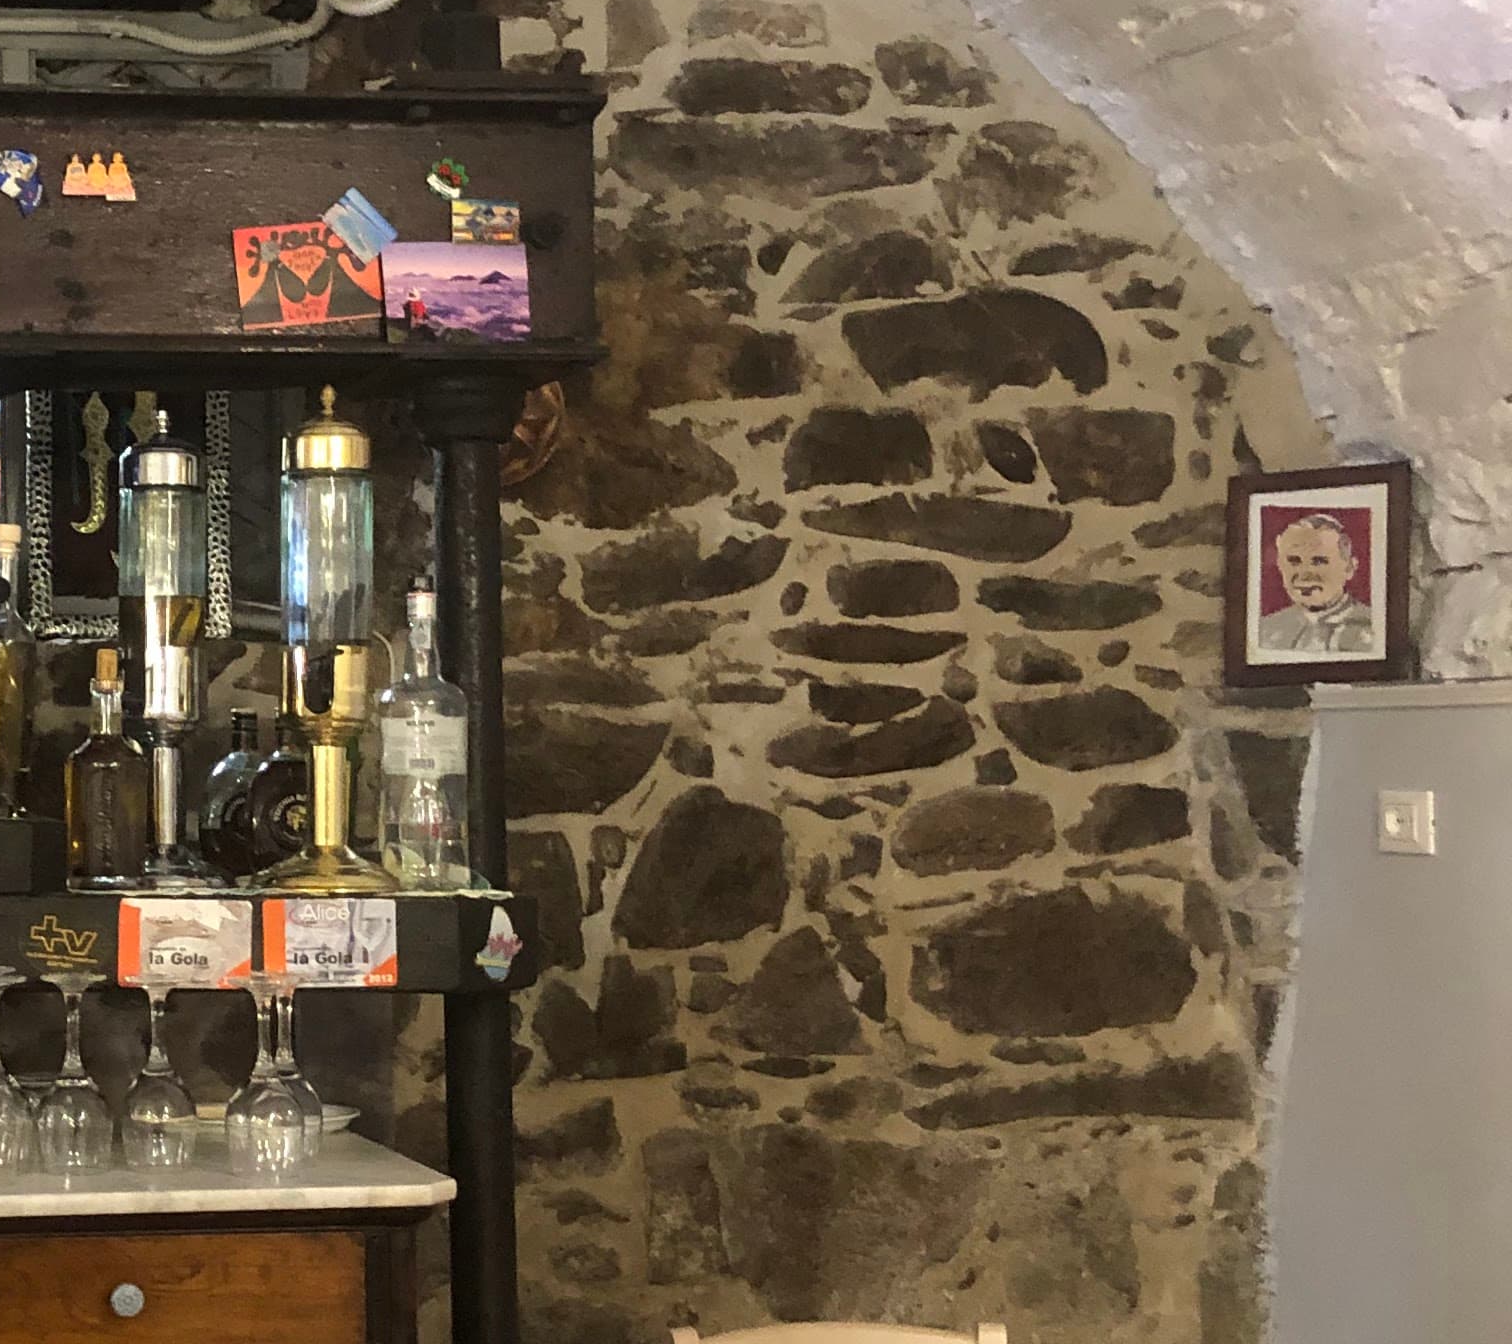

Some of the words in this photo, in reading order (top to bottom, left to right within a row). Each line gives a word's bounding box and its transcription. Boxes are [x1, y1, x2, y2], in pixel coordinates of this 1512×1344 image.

[299, 903, 351, 921] Alice
[148, 952, 164, 965] la
[170, 952, 209, 965] Gola
[294, 952, 309, 965] la
[315, 952, 353, 965] Gola
